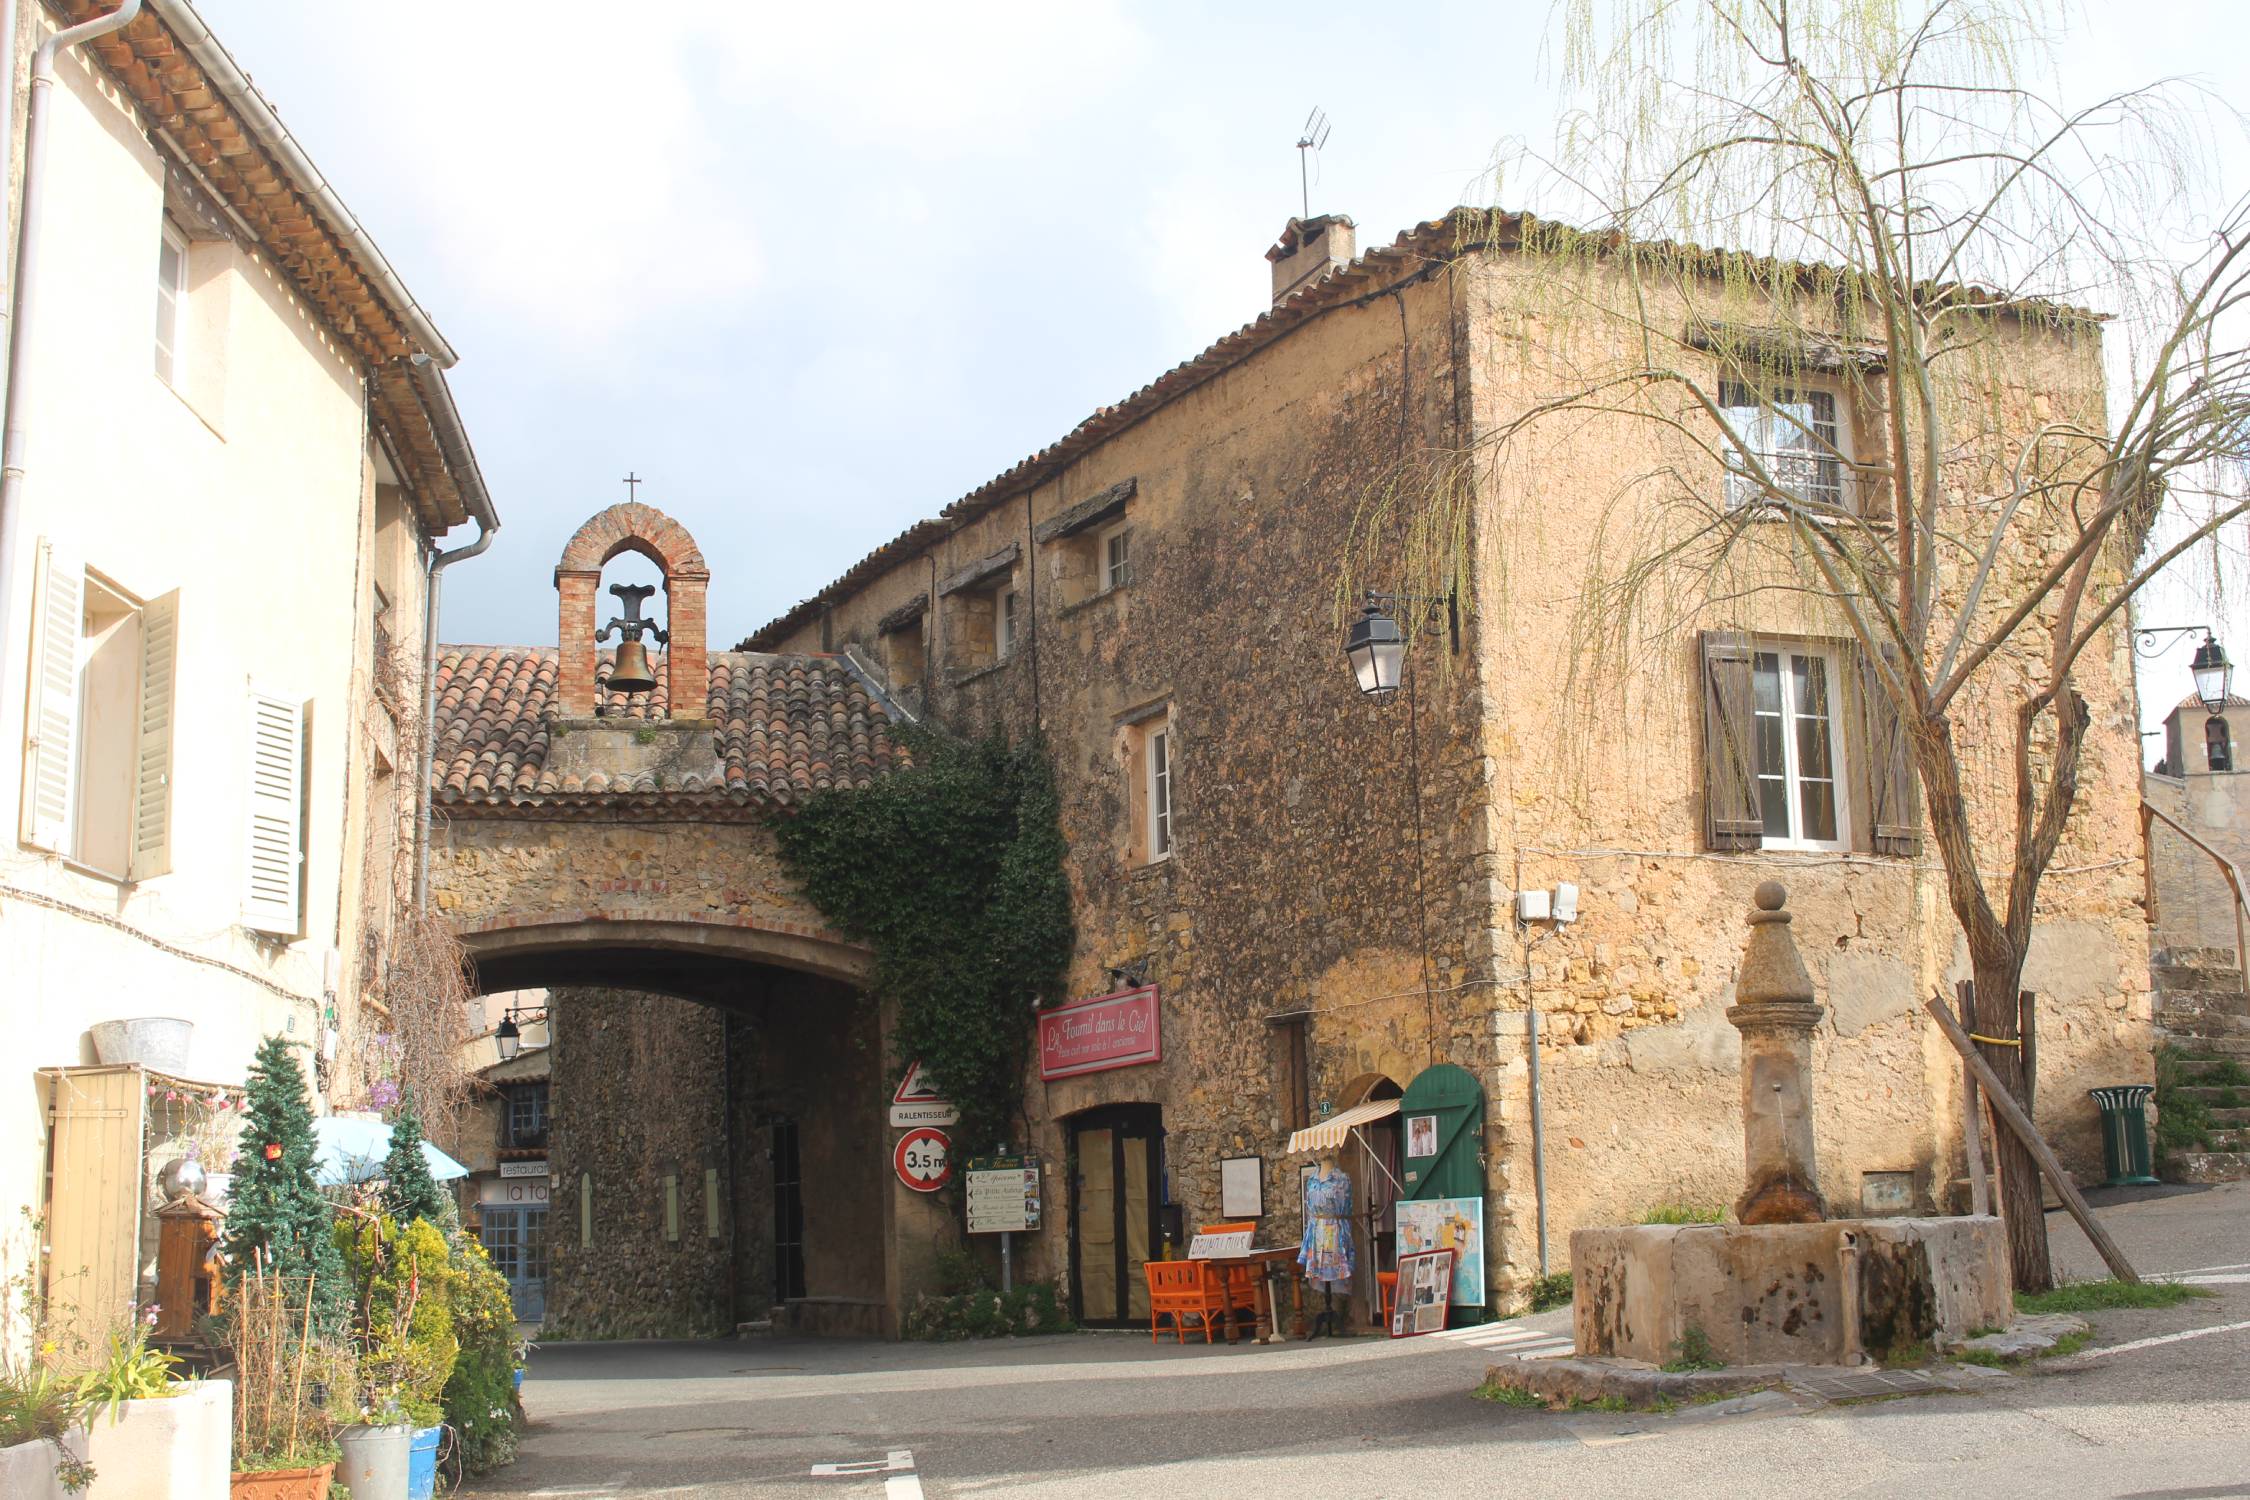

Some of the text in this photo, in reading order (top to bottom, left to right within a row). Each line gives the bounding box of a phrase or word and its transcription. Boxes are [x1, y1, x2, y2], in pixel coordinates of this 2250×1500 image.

[1095, 1011, 1115, 1034] dans
[1118, 1010, 1126, 1032] le
[1128, 1009, 1149, 1034] Ciel
[898, 1111, 952, 1120] RALENTISSEUR
[506, 1182, 522, 1200] la
